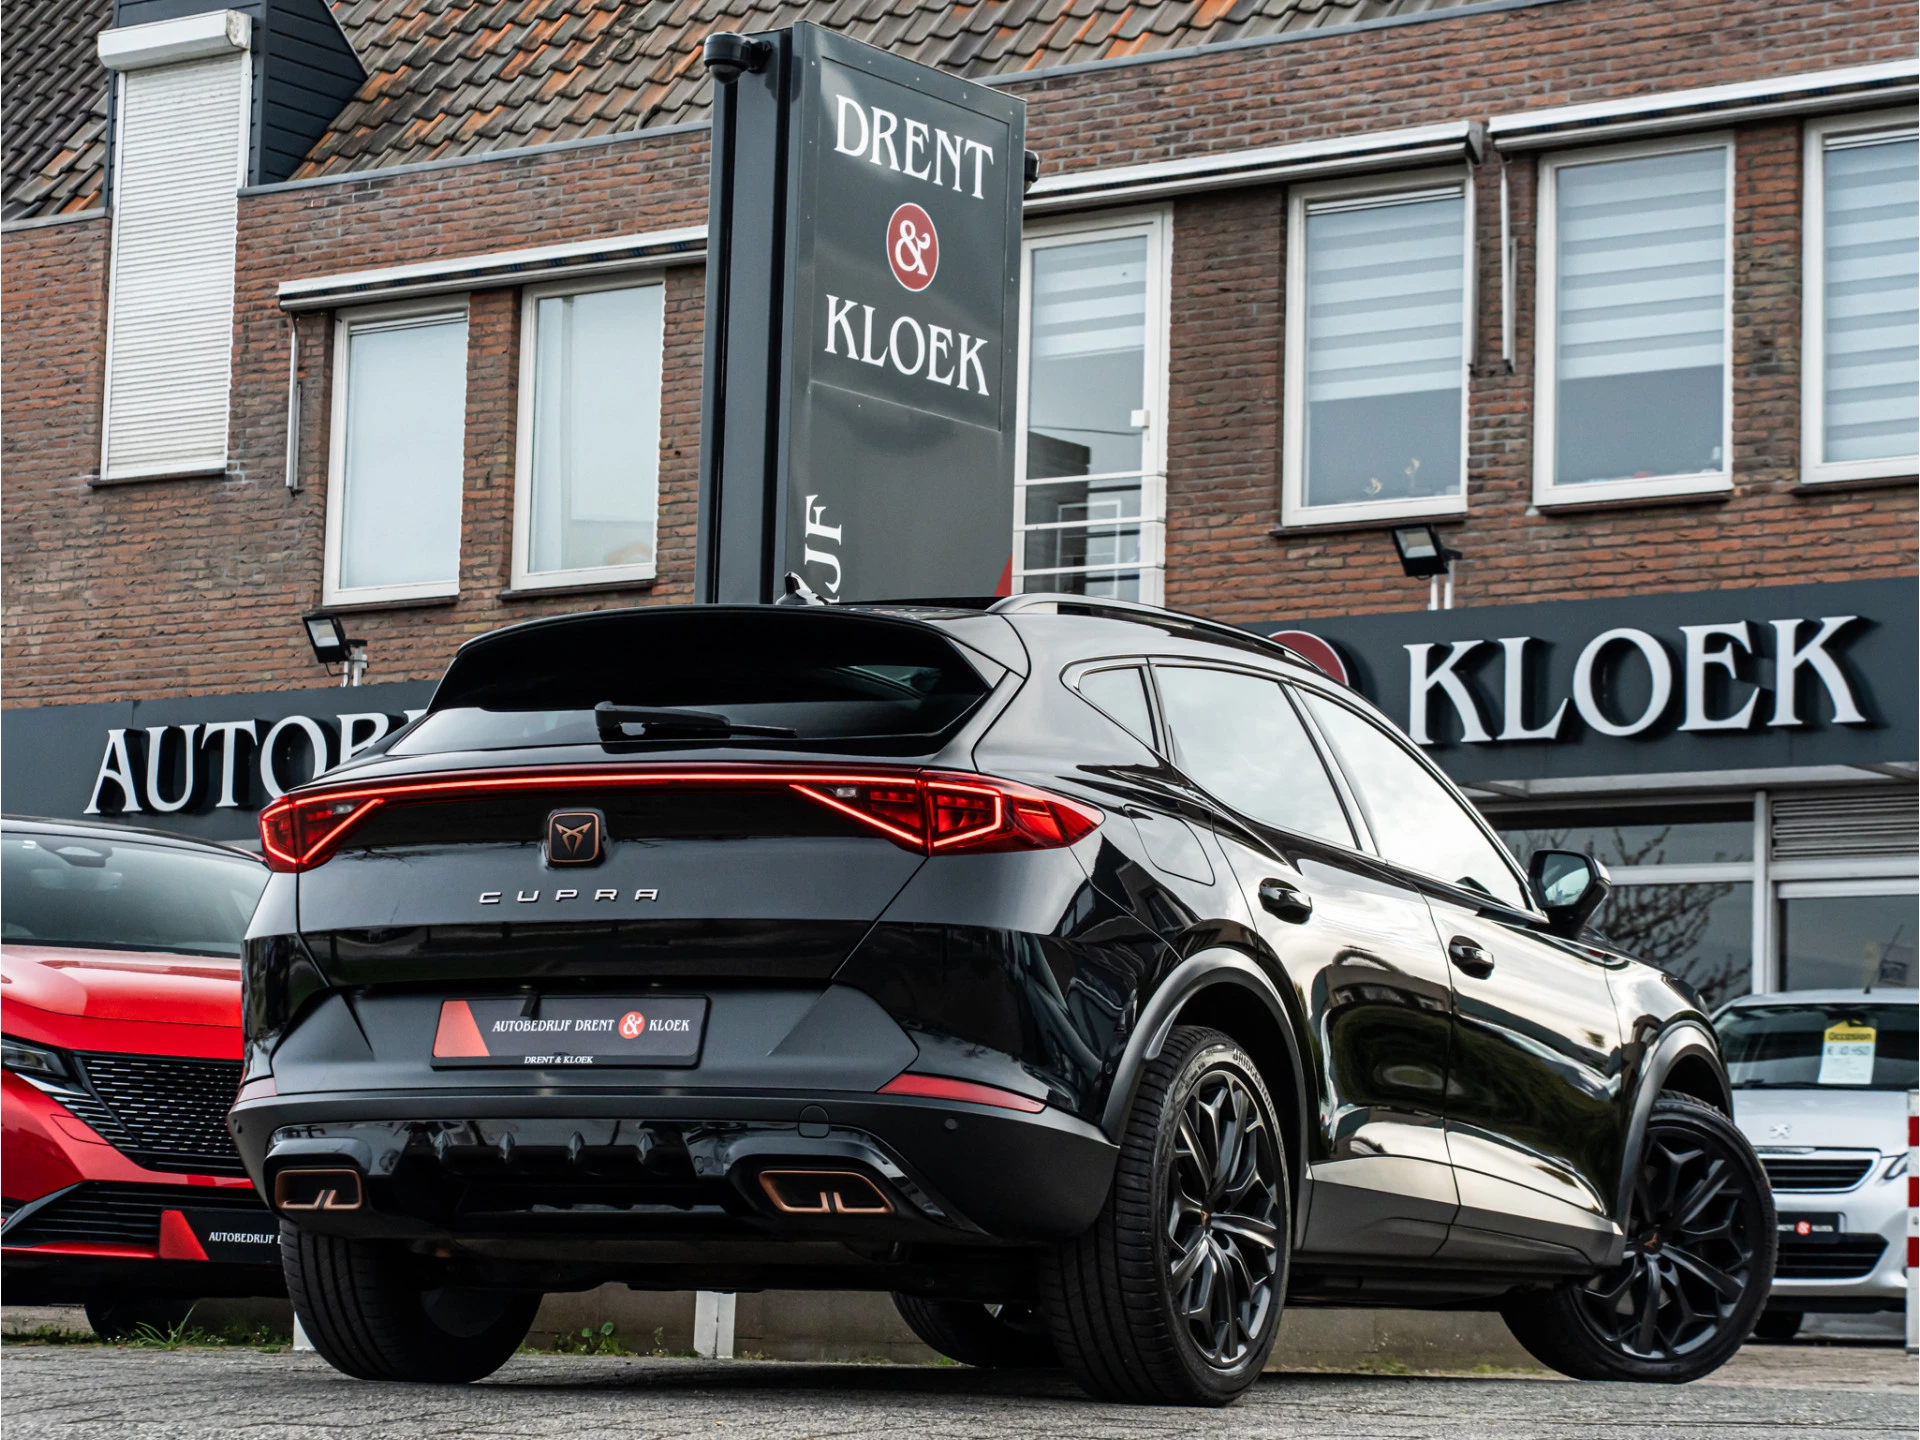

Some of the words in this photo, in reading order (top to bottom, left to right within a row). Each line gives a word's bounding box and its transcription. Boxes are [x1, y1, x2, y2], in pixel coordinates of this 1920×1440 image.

[834, 94, 994, 200] DRENT
[895, 220, 931, 276] &
[824, 294, 989, 396] KLOEK
[1403, 615, 1866, 745] KLOEK
[83, 709, 428, 815] AUTOB
[479, 888, 659, 904] CUPRA
[492, 1019, 573, 1033] AUTOBEDRIJF
[574, 1018, 616, 1032] DRENT
[622, 1014, 643, 1035] &
[648, 1019, 691, 1032] KLOEK
[524, 1056, 554, 1065] DRENT
[554, 1056, 562, 1065] &
[563, 1055, 594, 1065] KLOEK
[208, 1231, 275, 1244] AUTOBEDRIJF
